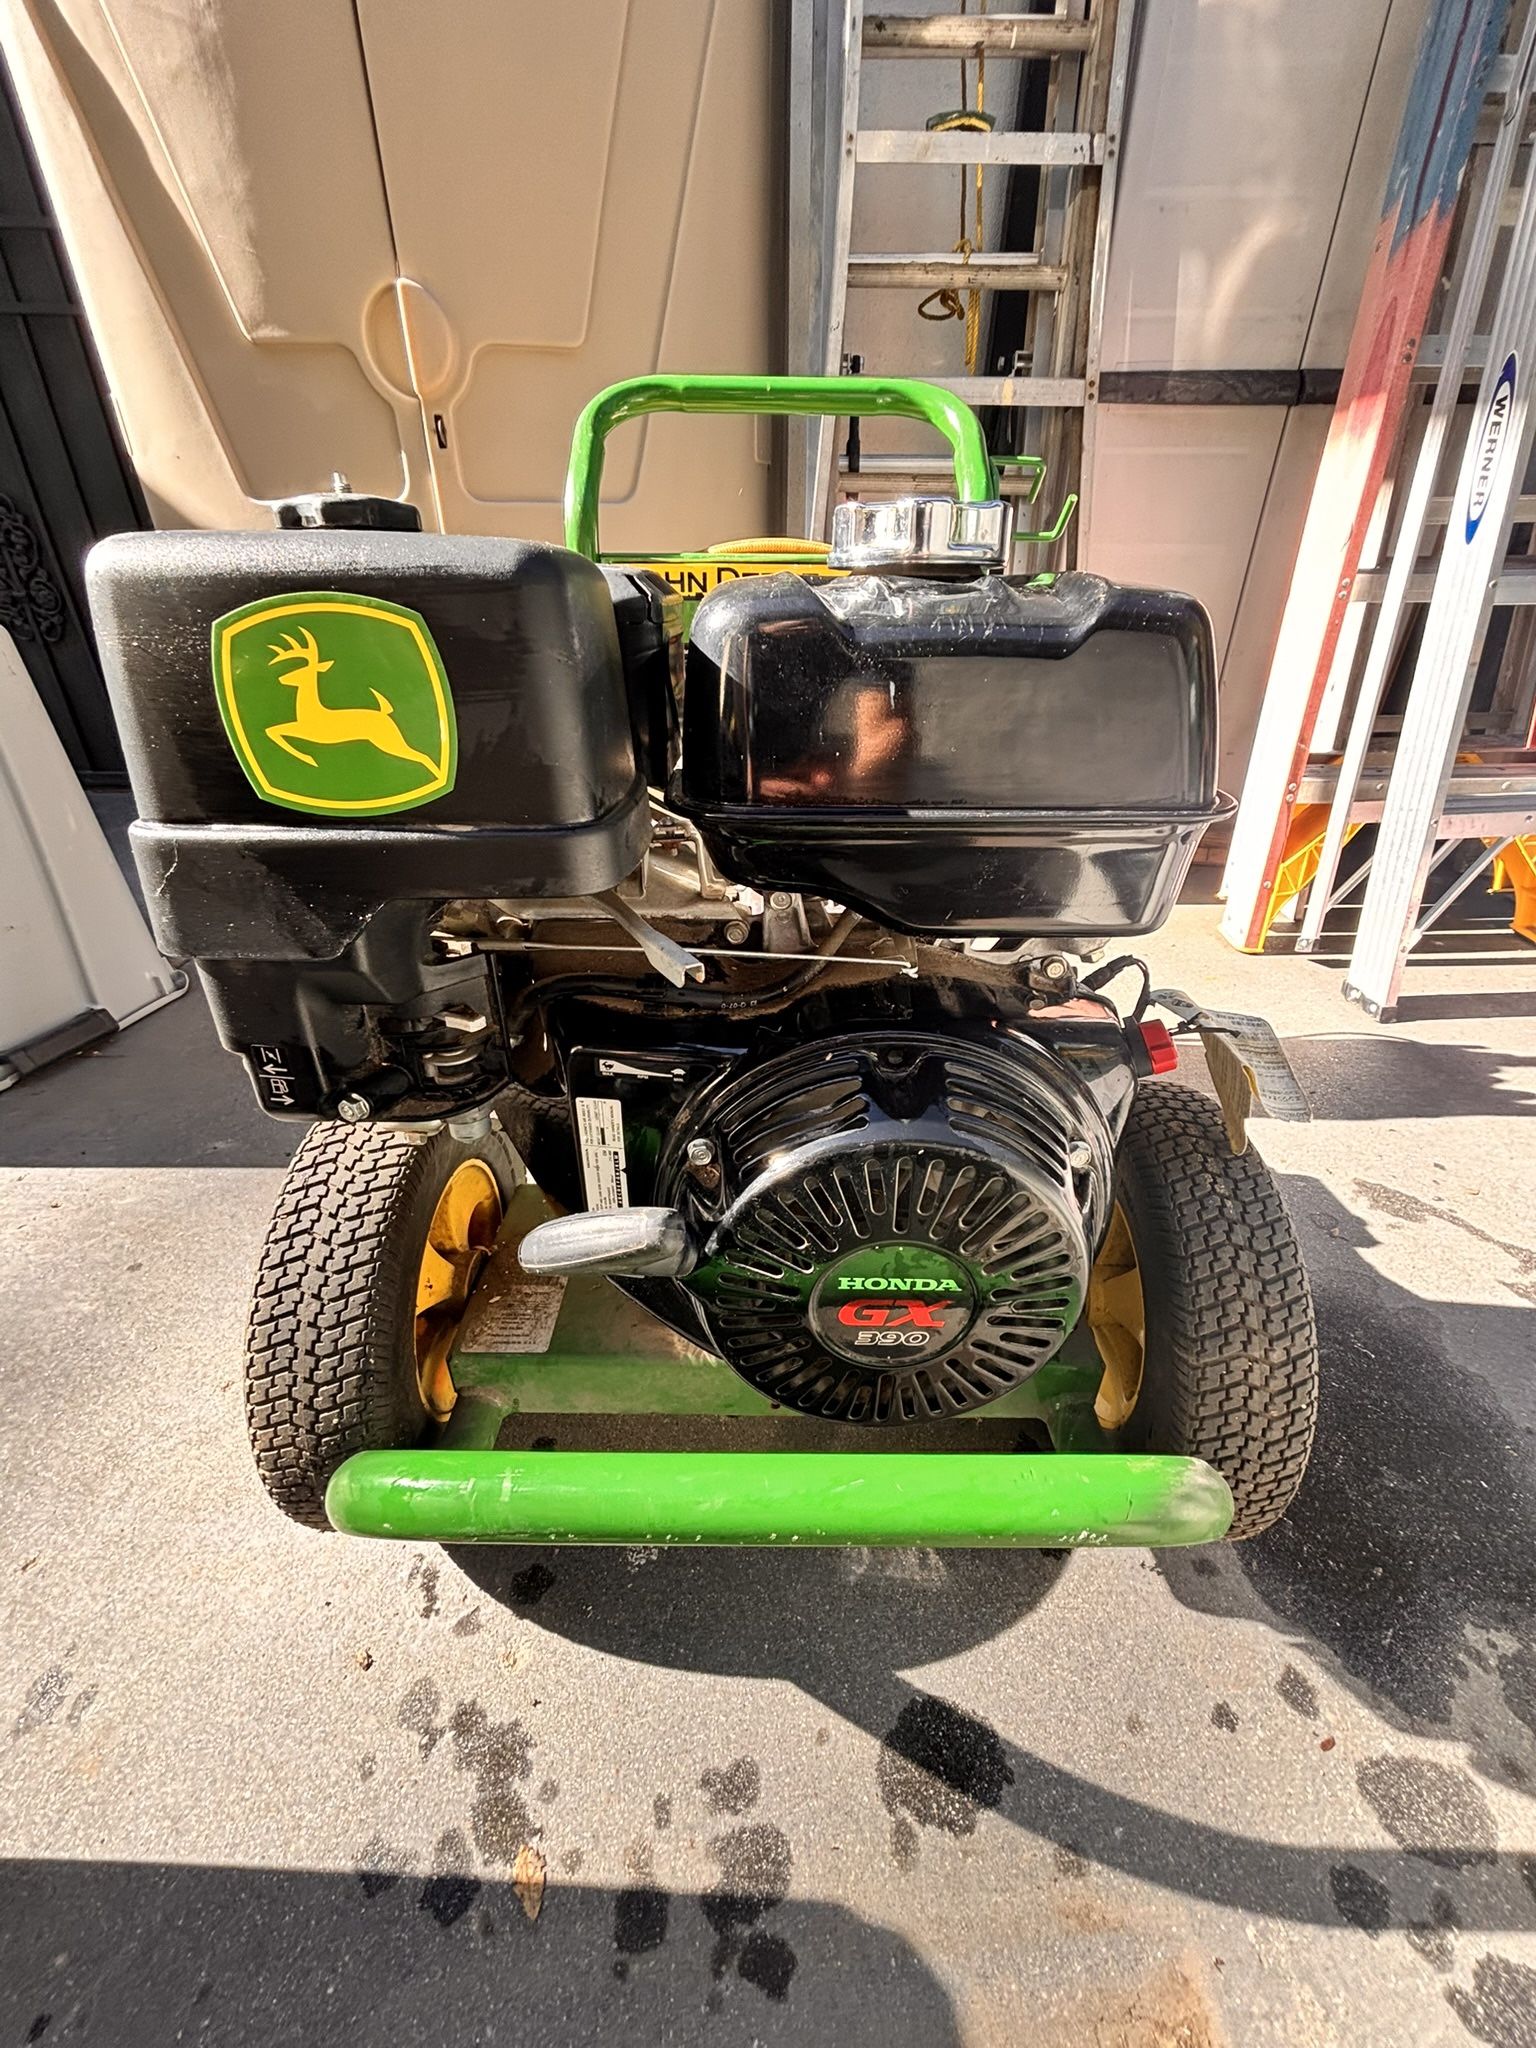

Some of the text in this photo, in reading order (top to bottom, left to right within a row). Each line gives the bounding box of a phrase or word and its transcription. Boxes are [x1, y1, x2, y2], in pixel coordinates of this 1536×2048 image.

[1473, 394, 1509, 507] WERNER
[665, 571, 707, 593] HN
[838, 1277, 962, 1292] HONDA
[837, 1299, 956, 1328] GX
[854, 1331, 930, 1346] 390
